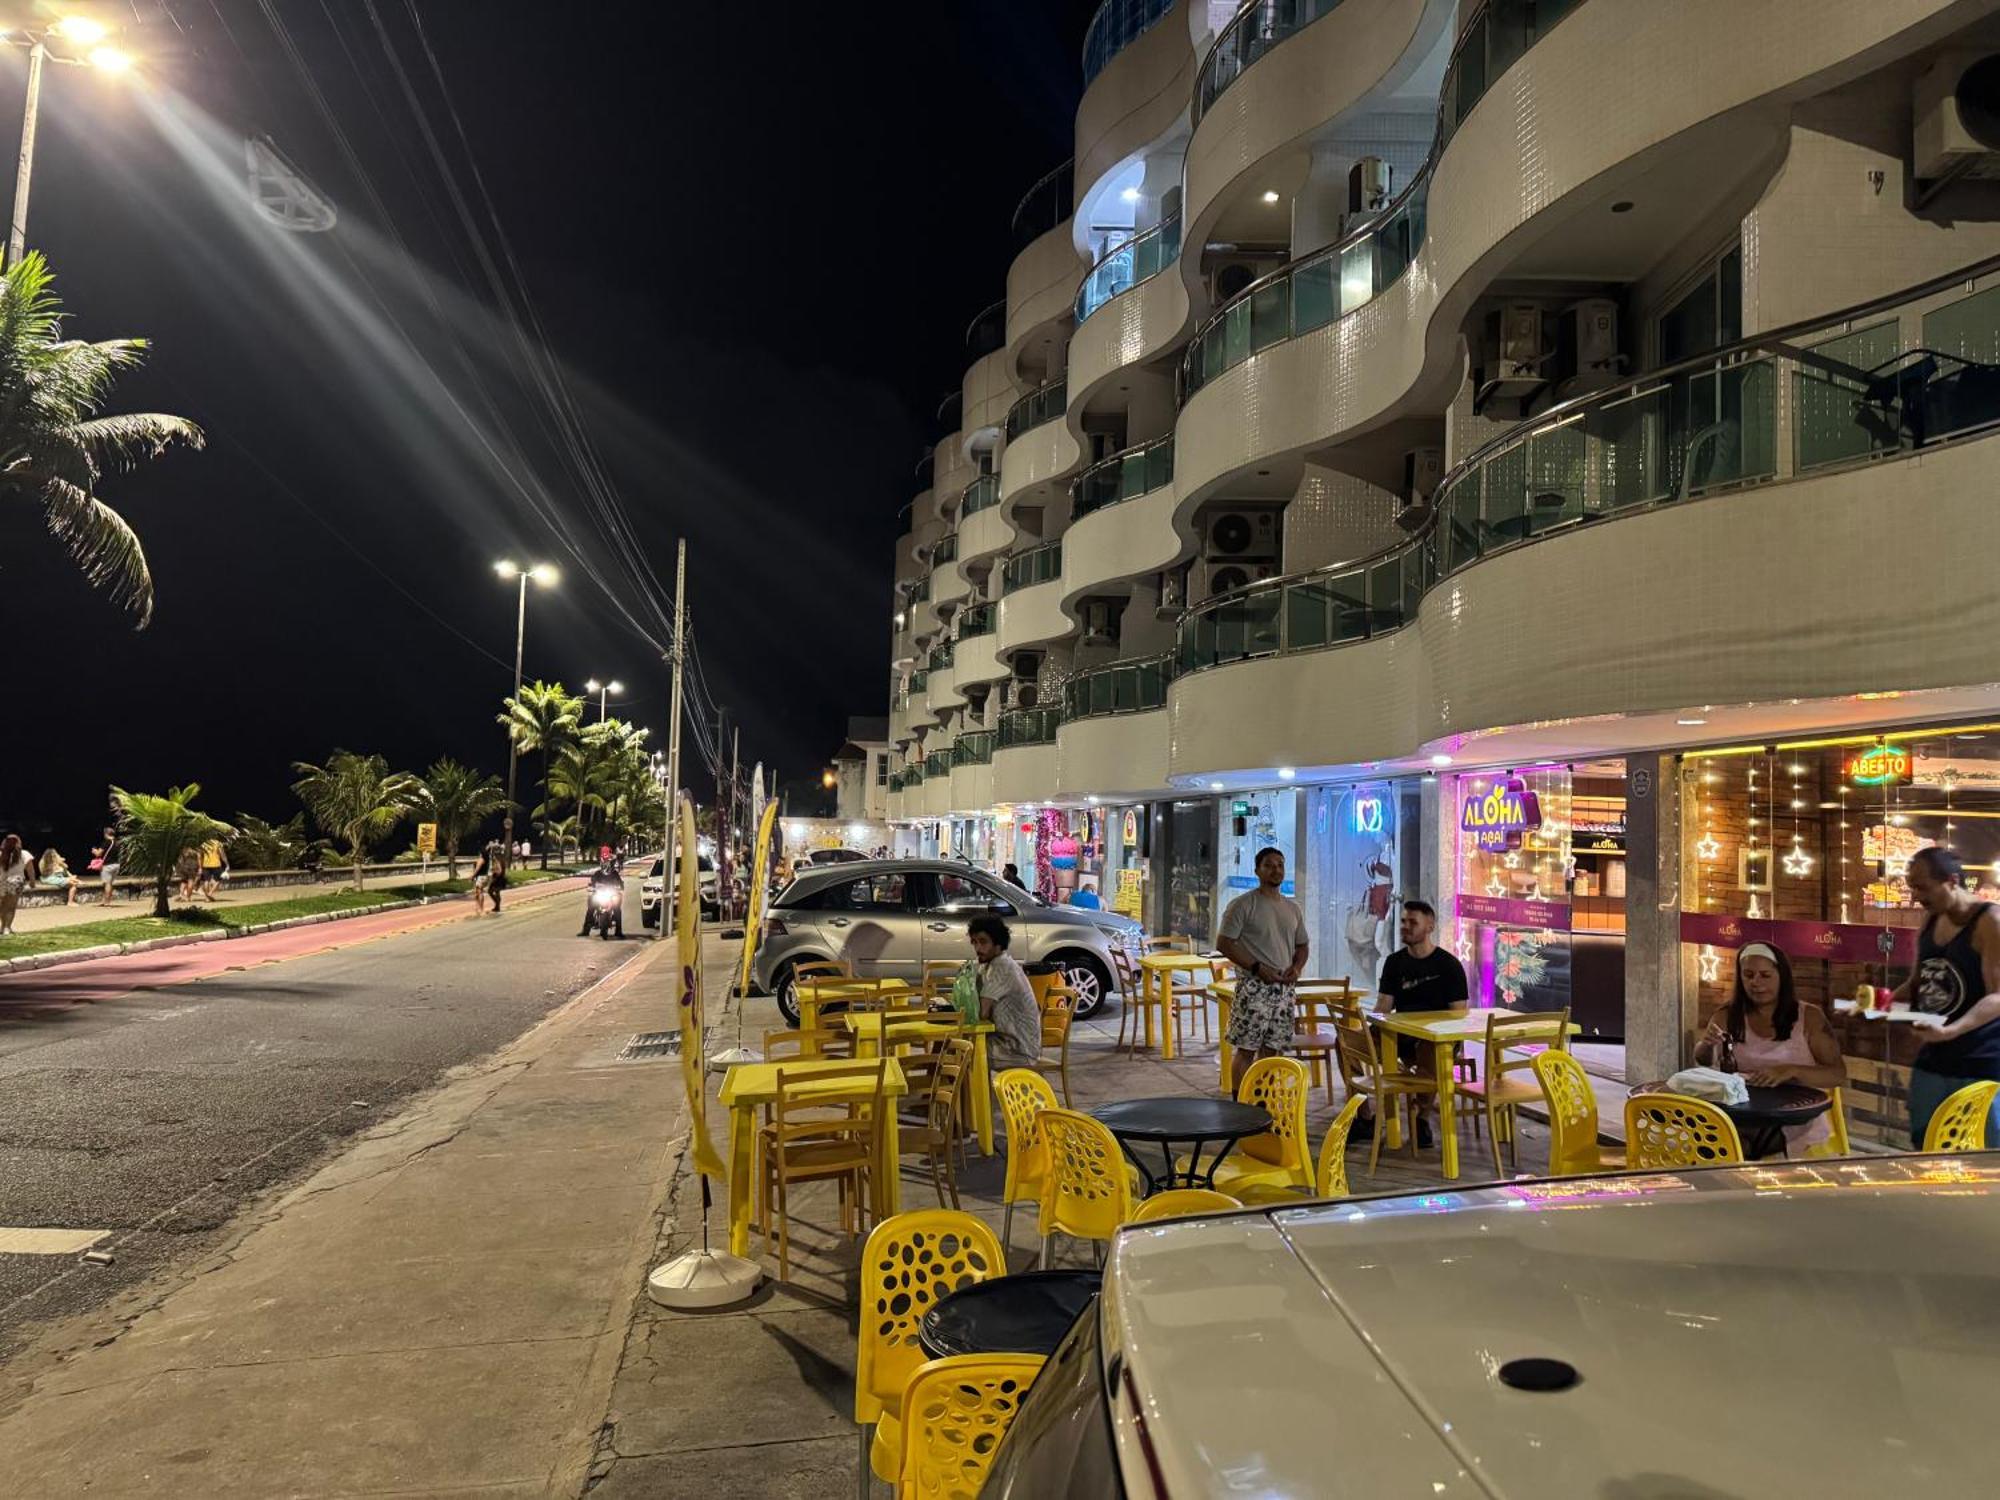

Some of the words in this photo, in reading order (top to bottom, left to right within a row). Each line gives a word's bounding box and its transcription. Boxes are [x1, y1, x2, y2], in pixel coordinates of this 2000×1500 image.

[1851, 757, 1905, 775] ABERTO
[1464, 793, 1524, 826] ALOHA
[1718, 924, 1741, 936] ALOHA
[1814, 932, 1842, 945] ALOHA
